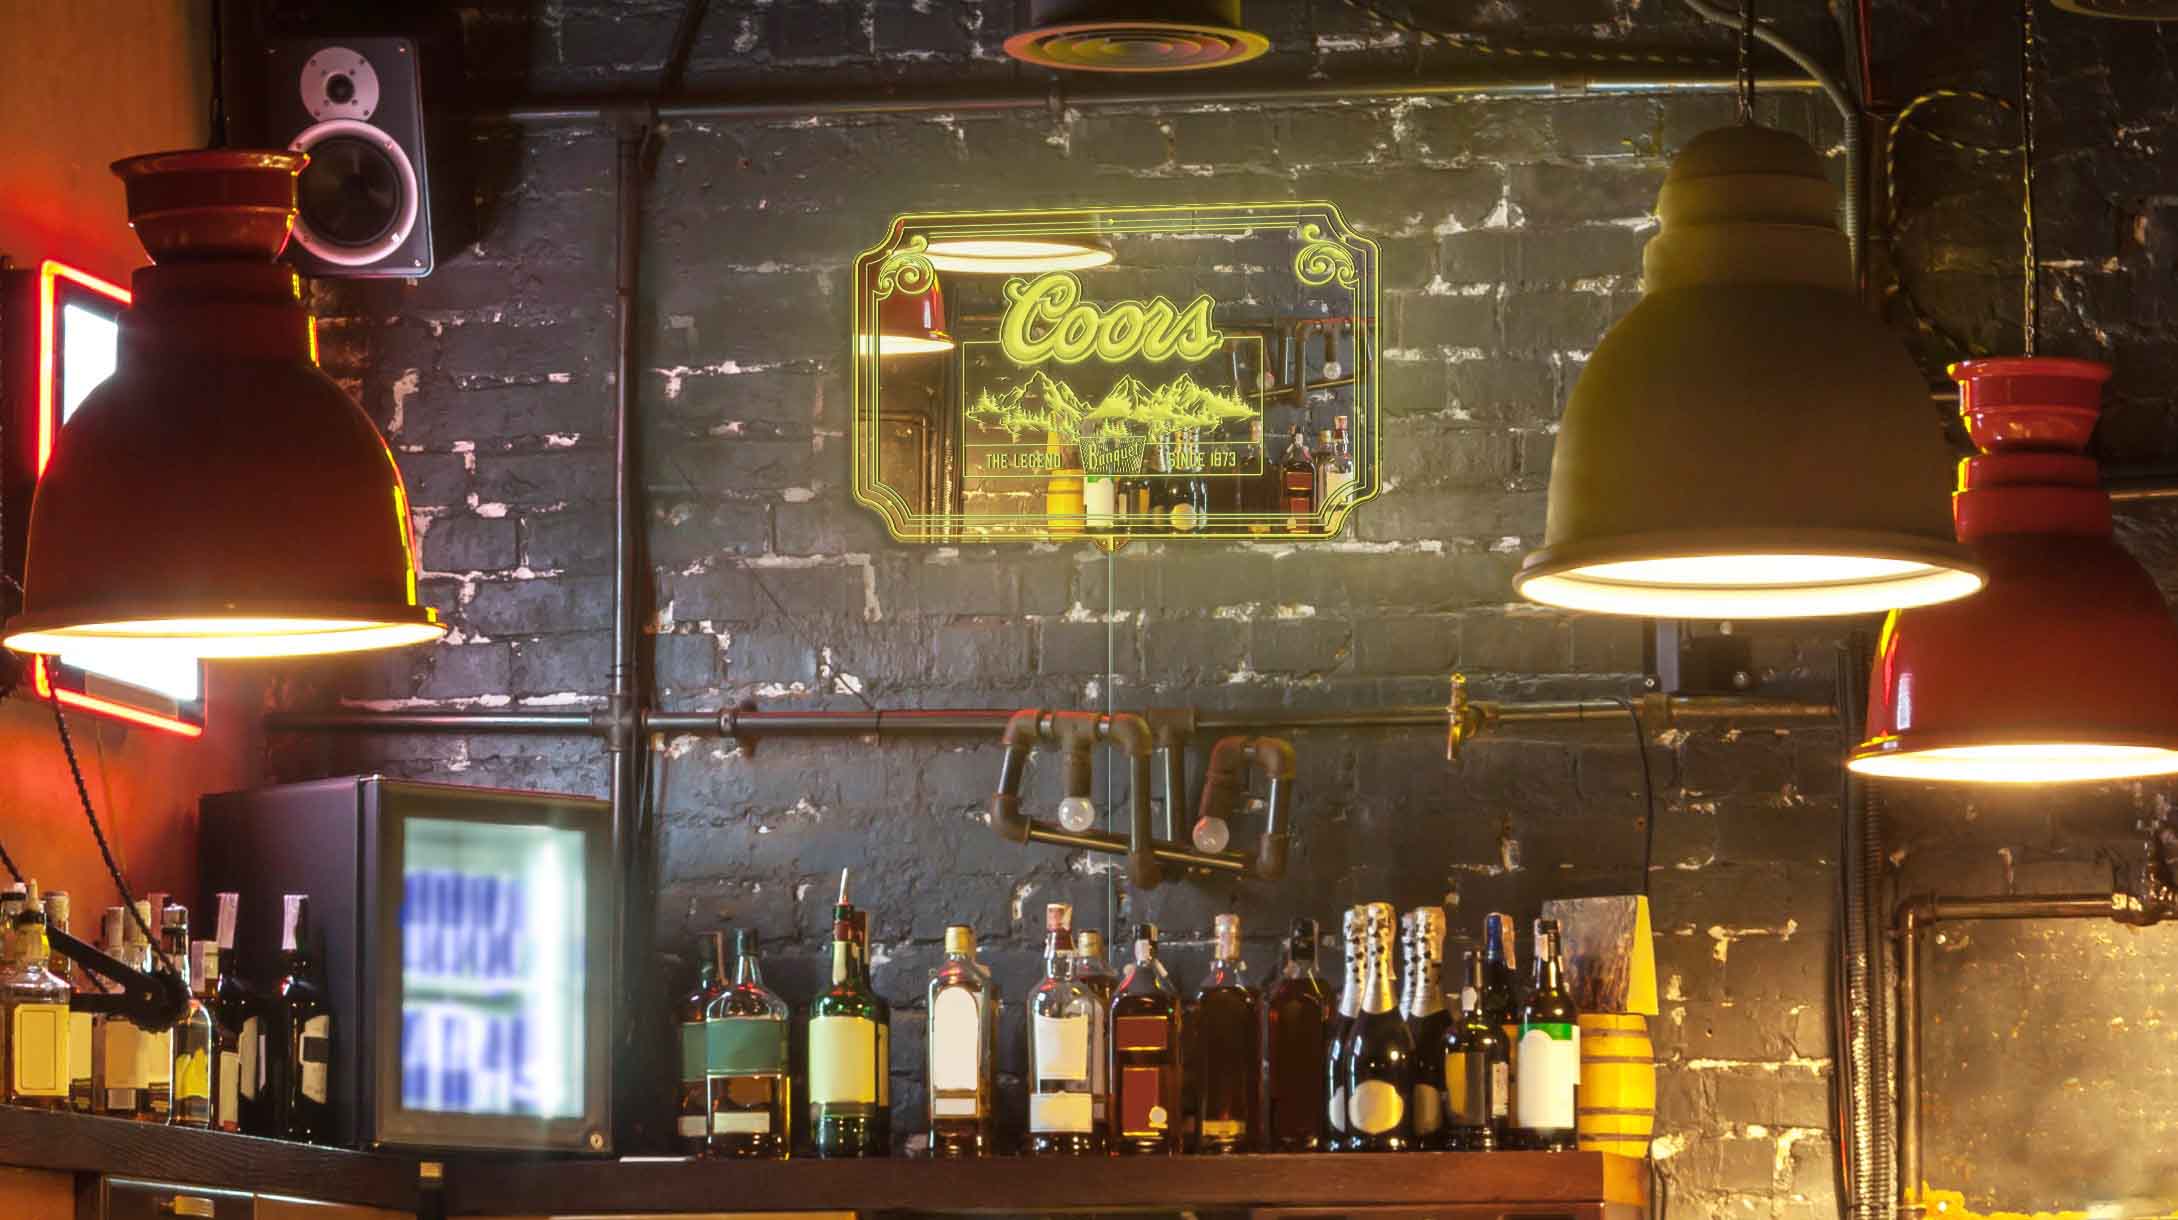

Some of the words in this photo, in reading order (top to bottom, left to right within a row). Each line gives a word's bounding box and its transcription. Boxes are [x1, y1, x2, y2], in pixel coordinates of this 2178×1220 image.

[1001, 271, 1224, 364] Coors
[985, 454, 1008, 469] THE
[1014, 453, 1062, 468] LEGEND
[1087, 441, 1140, 470] Banquet
[1168, 452, 1205, 468] SINCE
[1210, 451, 1237, 467] 1873
